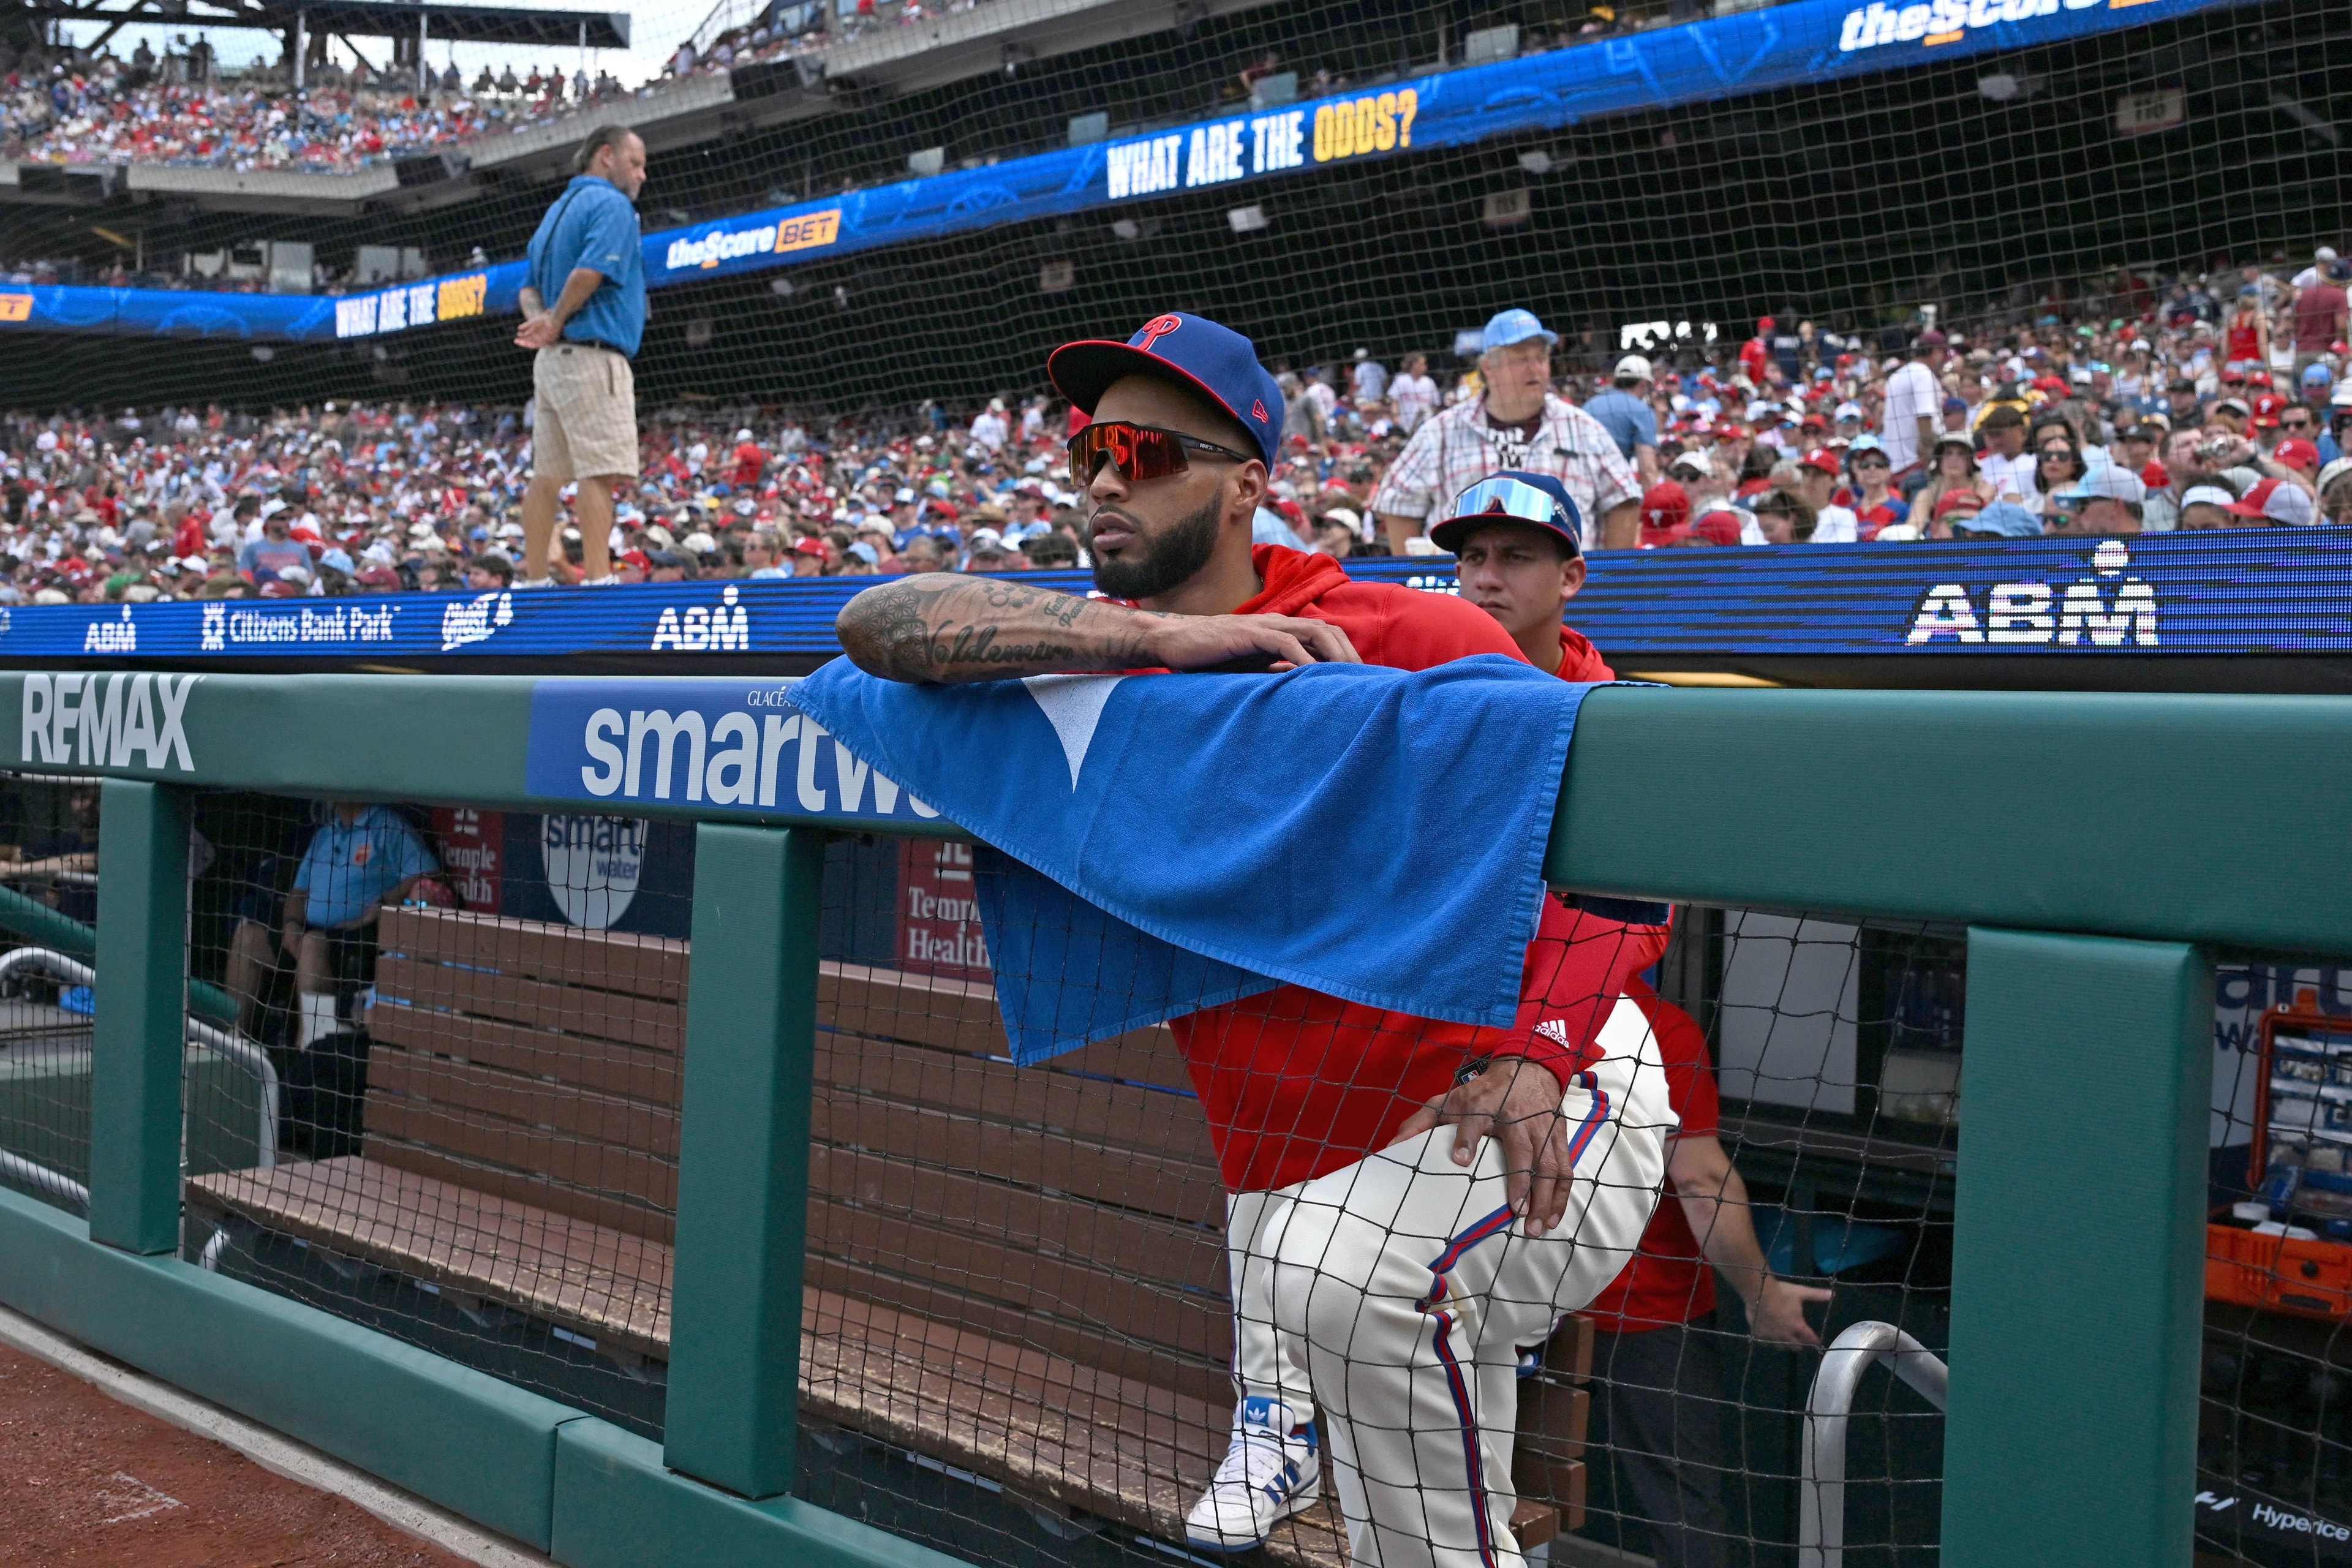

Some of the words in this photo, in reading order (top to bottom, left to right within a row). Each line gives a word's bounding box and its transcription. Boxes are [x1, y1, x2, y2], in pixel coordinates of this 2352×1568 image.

[1106, 135, 1182, 199] WHAT
[1186, 121, 1245, 187] ARE
[1251, 111, 1304, 173] THE
[1313, 89, 1418, 162] ODDS?
[666, 225, 777, 270] theScore
[782, 217, 832, 245] BET
[336, 295, 378, 338] WHAT
[377, 288, 407, 334] ARE
[409, 284, 435, 326] THE
[230, 610, 299, 642] Citizens
[301, 608, 347, 641] Bank
[350, 604, 394, 641] Park
[650, 606, 749, 650] ABM
[1905, 577, 2160, 646] ABM
[84, 622, 136, 653] ABM
[581, 707, 942, 818] smartw
[596, 858, 639, 880] water
[908, 886, 981, 932] Temp
[1532, 1024, 1569, 1049] adidas
[2252, 1503, 2350, 1541] Hyperice
